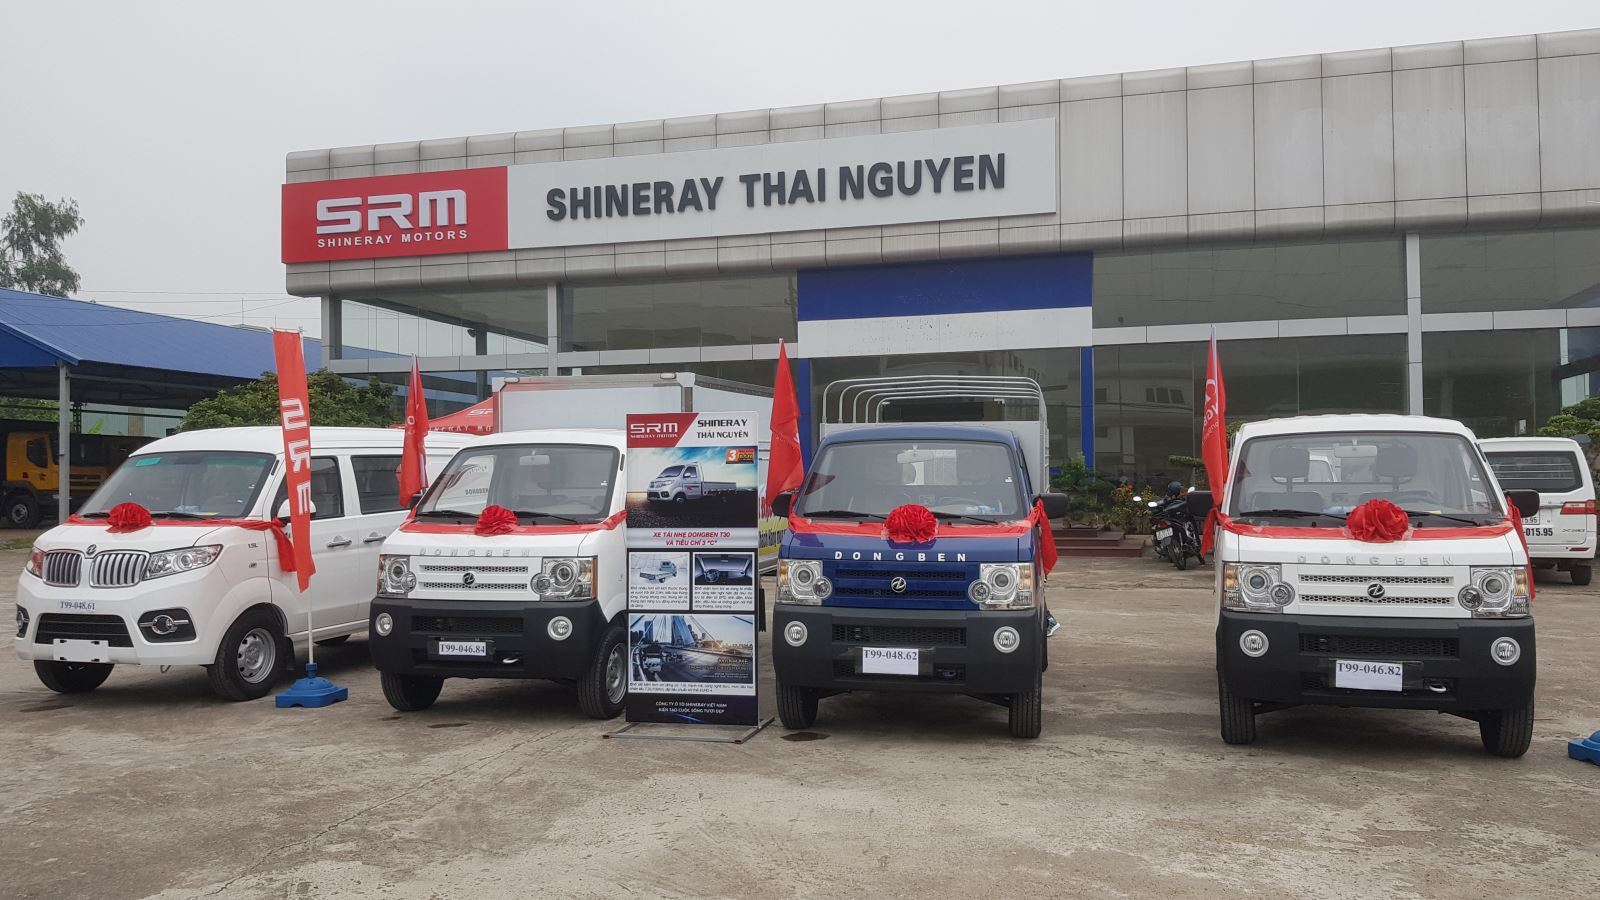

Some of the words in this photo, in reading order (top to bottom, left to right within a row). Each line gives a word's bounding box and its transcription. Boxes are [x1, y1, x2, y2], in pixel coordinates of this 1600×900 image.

[546, 176, 725, 221] SHINERAY
[739, 167, 826, 208] THAI
[839, 153, 1005, 201] NGUYEN
[316, 189, 467, 235] SRM
[317, 234, 393, 248] SHINERAY
[401, 229, 468, 243] MOTORS
[630, 422, 678, 434] SRM
[697, 418, 748, 427] SHINERAY
[697, 430, 715, 439] THÁI
[717, 429, 749, 439] NGUYÊN
[728, 449, 736, 461] 3
[834, 551, 966, 562] DONGBEN
[1297, 555, 1454, 566] DONGBEN
[439, 643, 485, 654] T99-046.84
[864, 649, 917, 661] T99-048.62
[1337, 662, 1401, 676] T99-046.82
